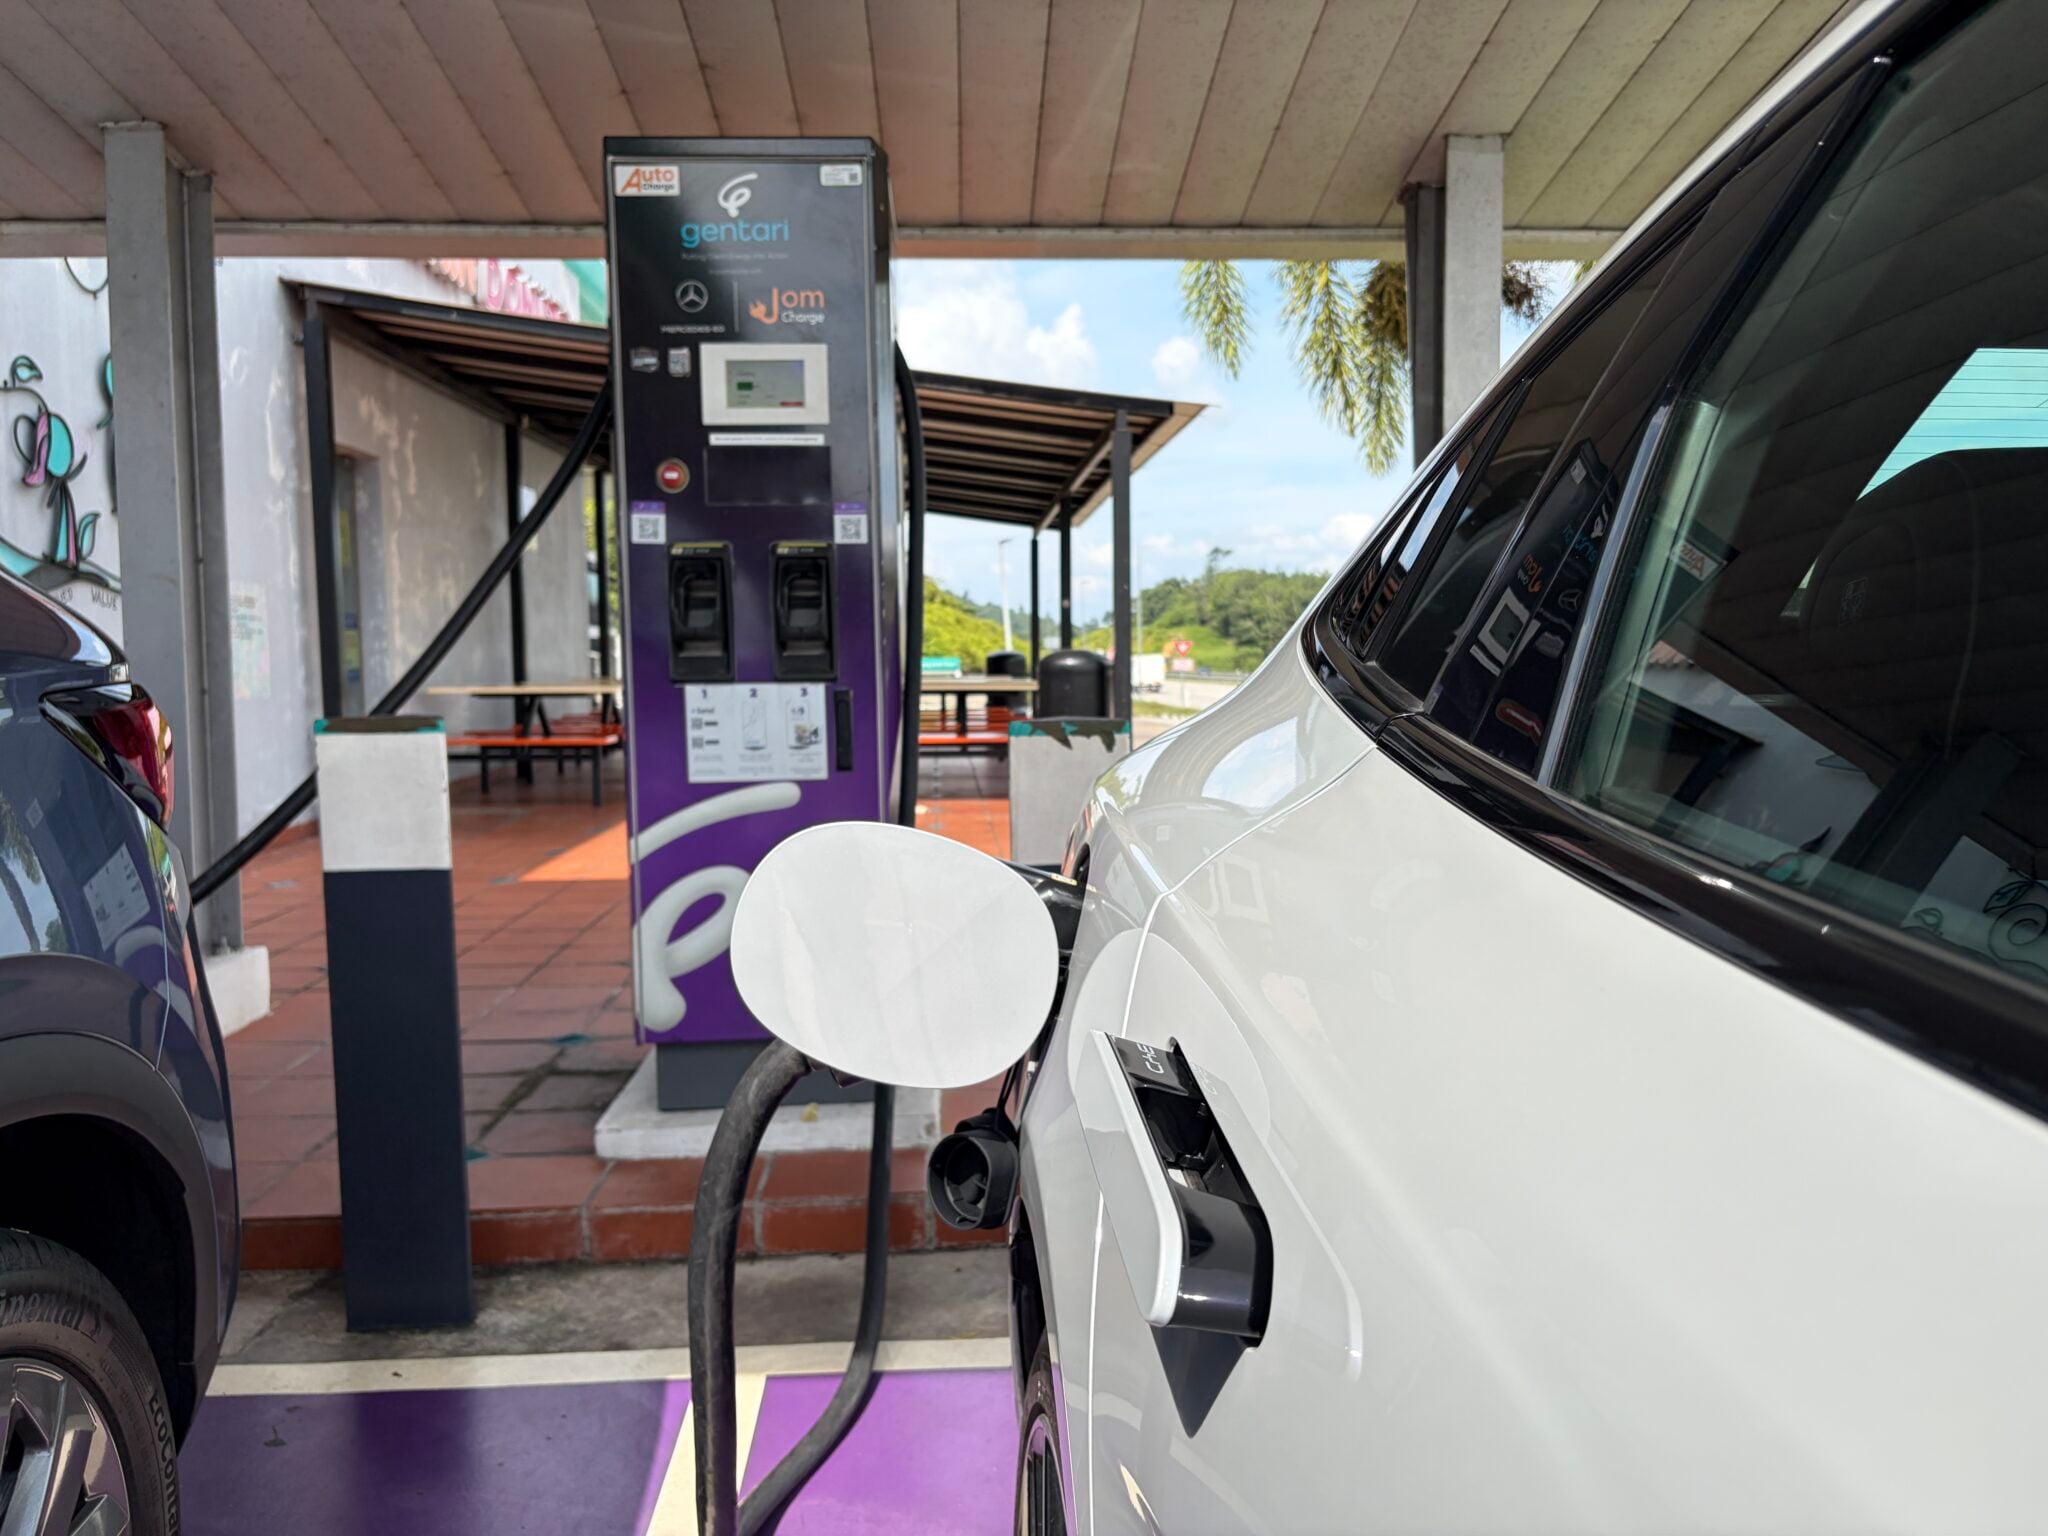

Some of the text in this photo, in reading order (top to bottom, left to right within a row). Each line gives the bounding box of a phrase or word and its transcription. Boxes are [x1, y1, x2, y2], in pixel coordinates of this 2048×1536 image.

[619, 167, 674, 193] Auto
[642, 183, 675, 192] Charge
[680, 218, 789, 248] gentari
[748, 287, 825, 325] Jom
[781, 310, 825, 325] Charge
[701, 689, 708, 699] 1
[749, 688, 758, 698] 2
[800, 687, 808, 697] 3
